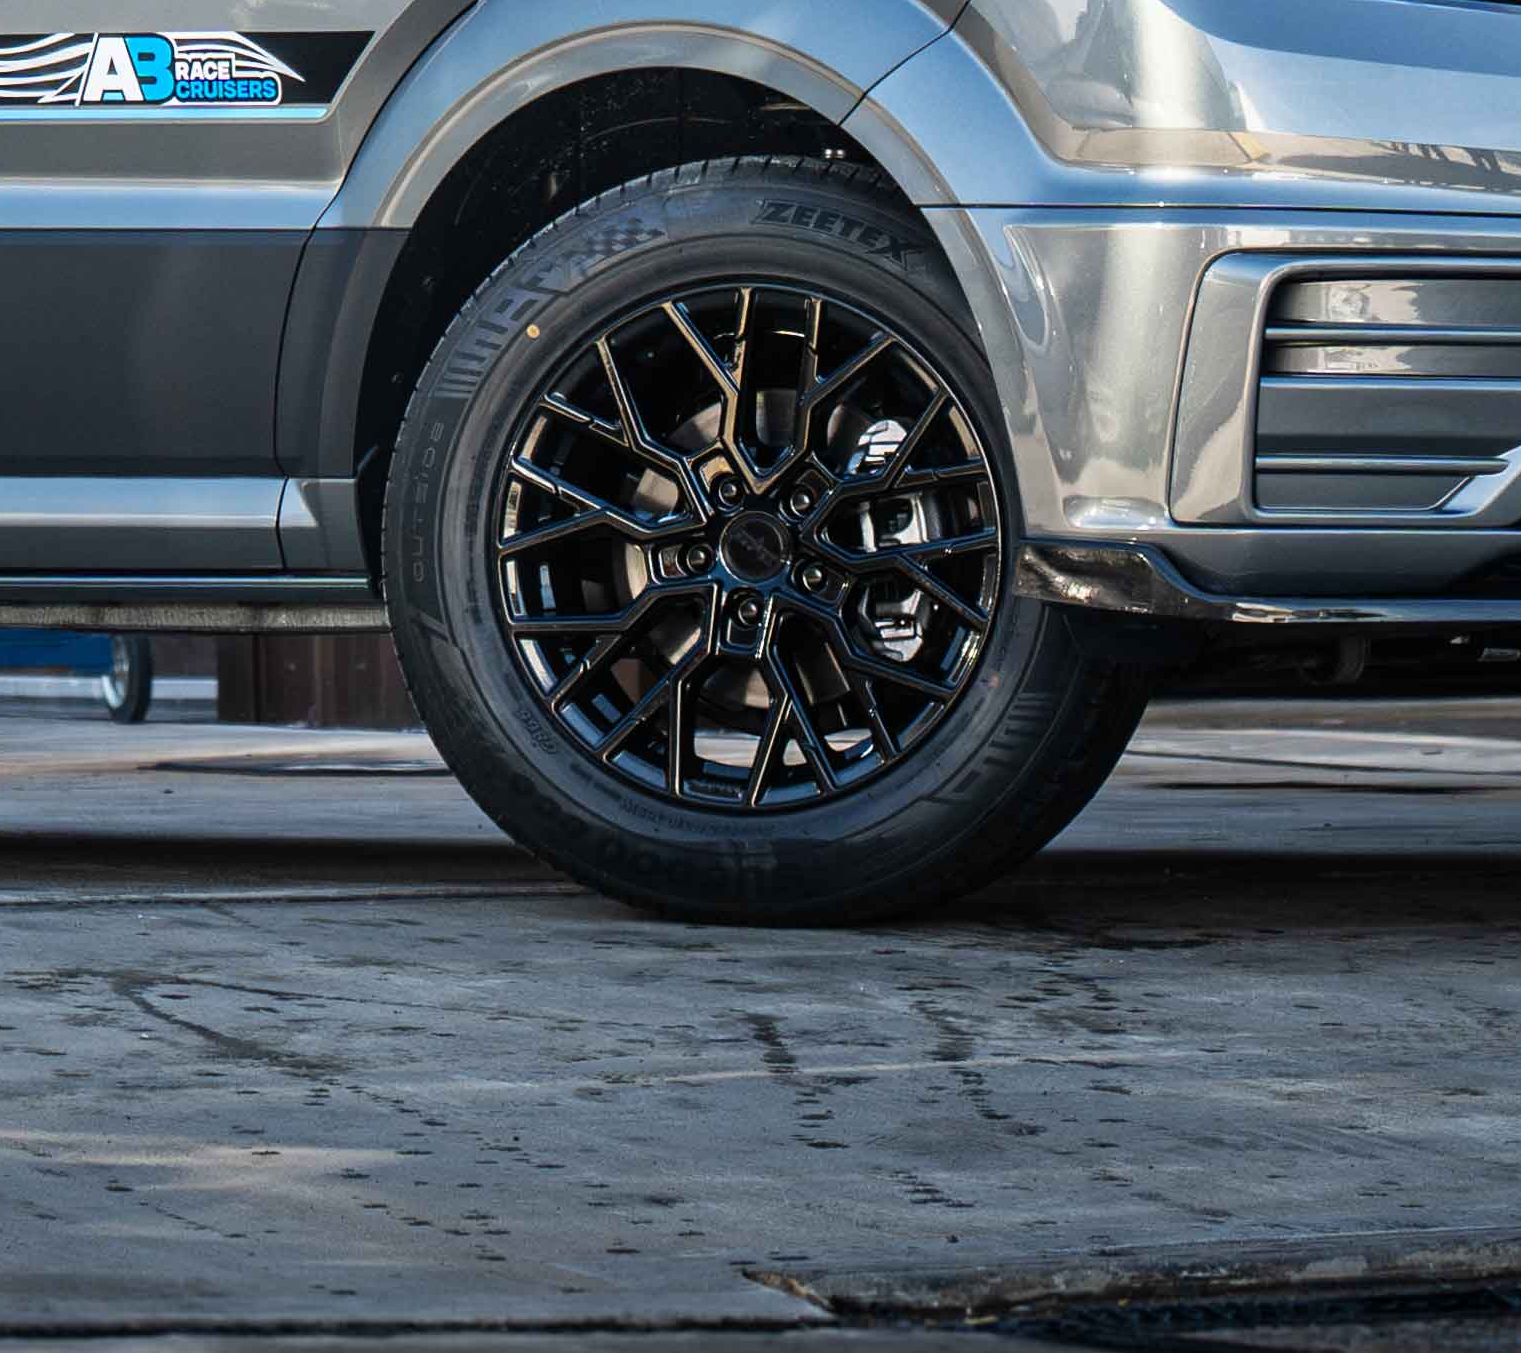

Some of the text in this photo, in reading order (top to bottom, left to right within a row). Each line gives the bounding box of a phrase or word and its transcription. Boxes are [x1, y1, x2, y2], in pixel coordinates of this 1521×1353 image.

[82, 32, 176, 102] AB
[175, 58, 232, 81] RACE
[175, 79, 276, 100] CRUISERS
[754, 199, 922, 269] ZEETEX
